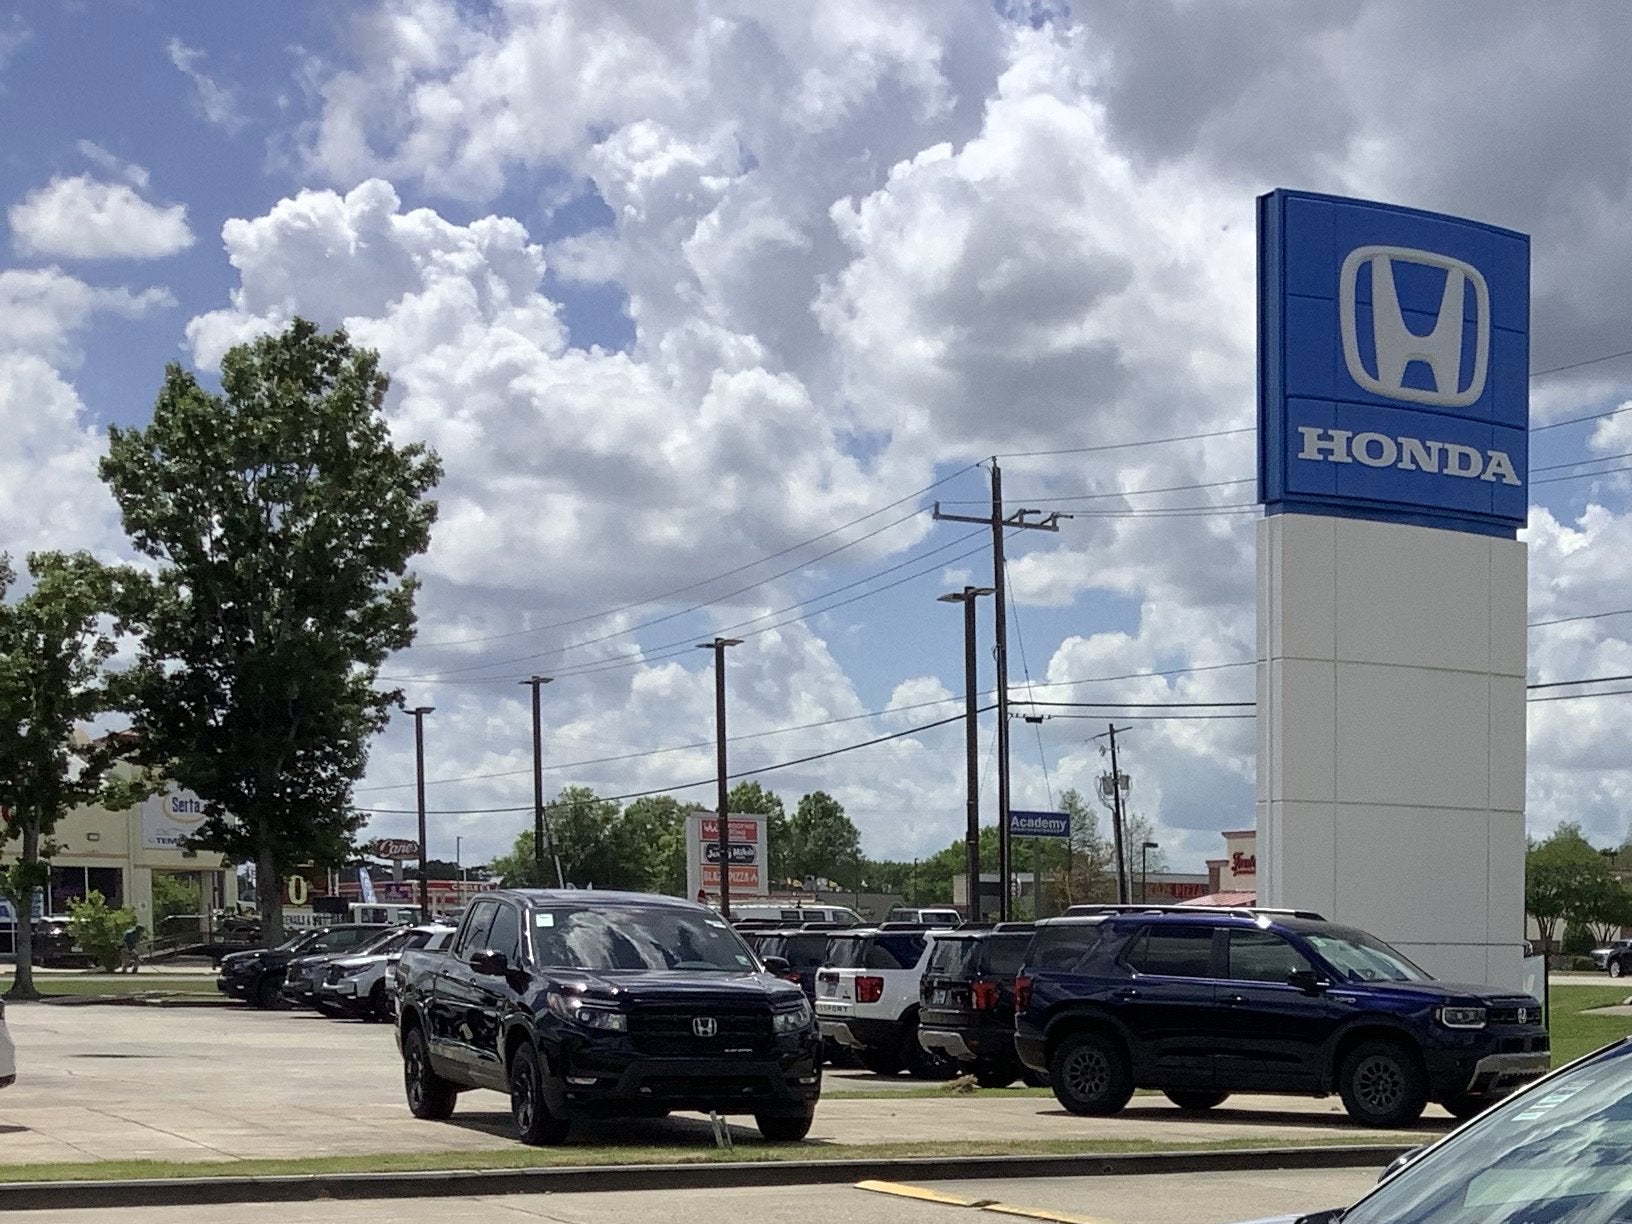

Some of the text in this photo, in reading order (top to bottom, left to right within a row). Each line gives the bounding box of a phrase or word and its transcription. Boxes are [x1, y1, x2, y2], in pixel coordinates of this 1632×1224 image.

[1298, 427, 1522, 486] HONDA
[172, 797, 200, 813] Serta
[1010, 815, 1067, 832] Academy
[379, 839, 419, 858] Cane's
